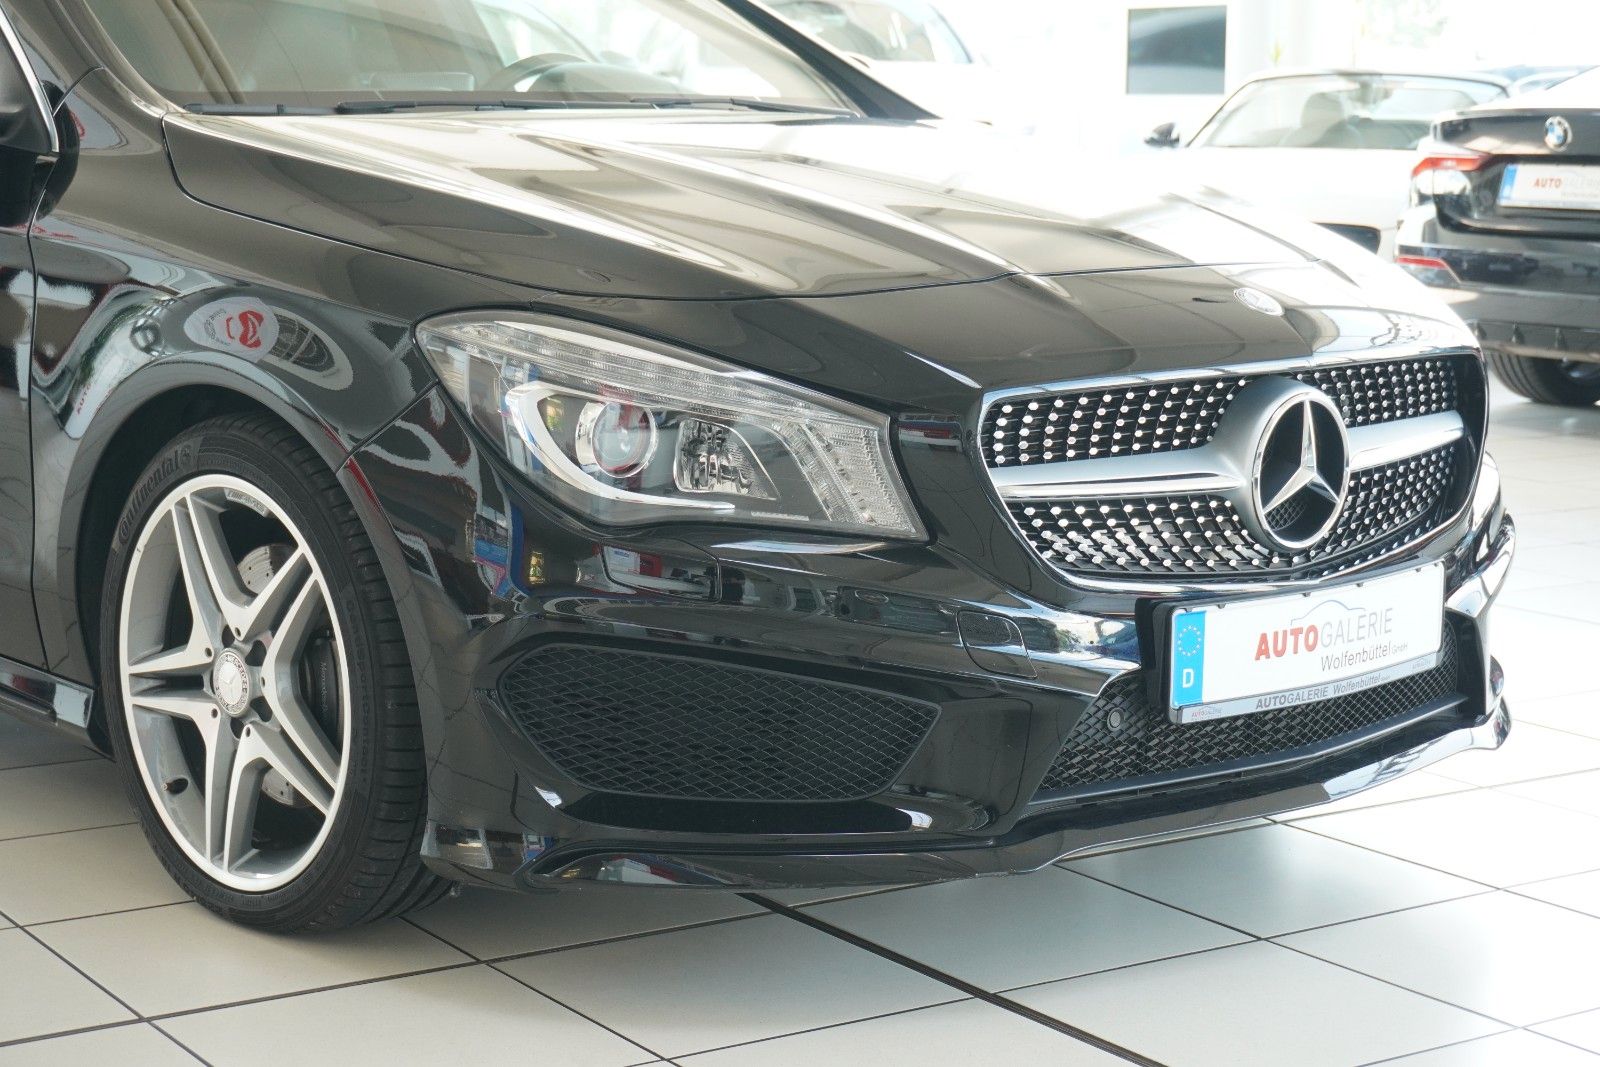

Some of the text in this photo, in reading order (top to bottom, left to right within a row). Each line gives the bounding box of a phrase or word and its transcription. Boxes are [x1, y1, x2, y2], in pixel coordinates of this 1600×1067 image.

[1320, 640, 1391, 672] Wolfenbüttel
[1181, 668, 1195, 689] D
[1255, 673, 1381, 710] AUTOGALERIE Wolfenbüttel
